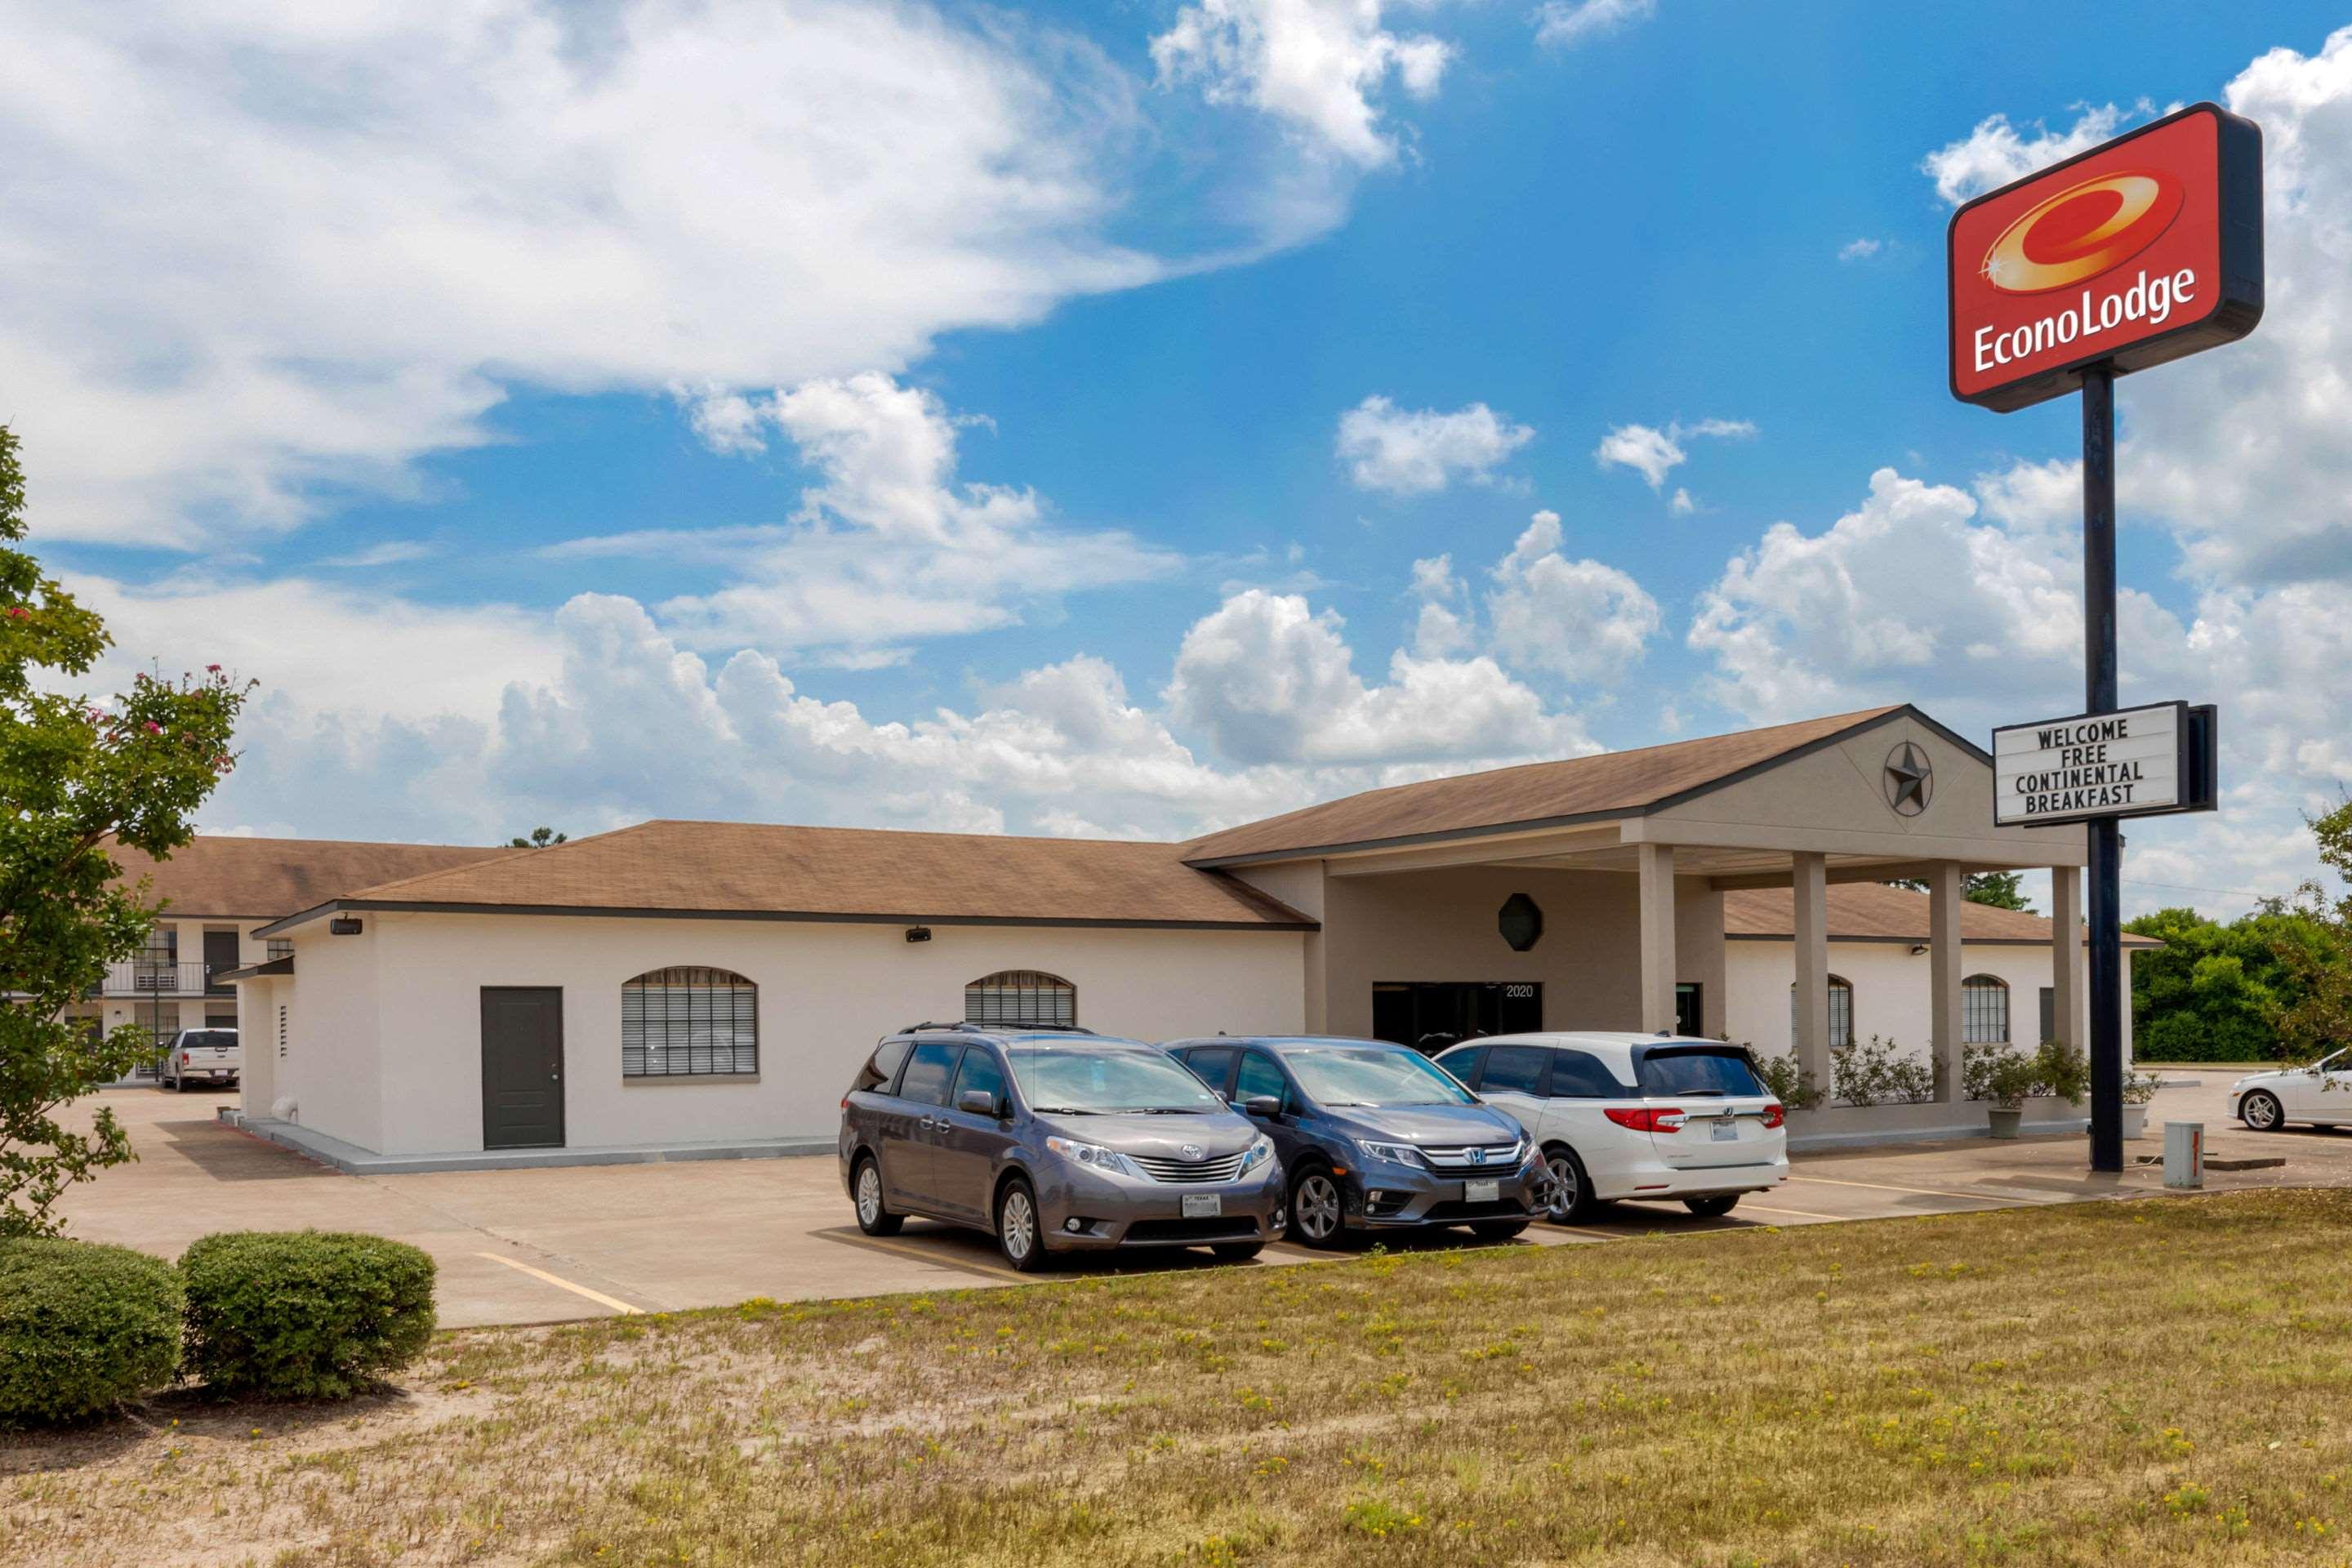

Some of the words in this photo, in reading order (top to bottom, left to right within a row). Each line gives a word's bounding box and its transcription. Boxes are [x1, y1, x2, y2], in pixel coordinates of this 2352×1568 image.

[1974, 268, 2195, 372] EconoLodge
[2038, 719, 2128, 750] WELCOME
[2061, 744, 2107, 768] FREE
[2016, 761, 2144, 794] CONTINENTAL
[2025, 784, 2134, 814] BREAKFAST
[1506, 985, 1533, 997] 2020
